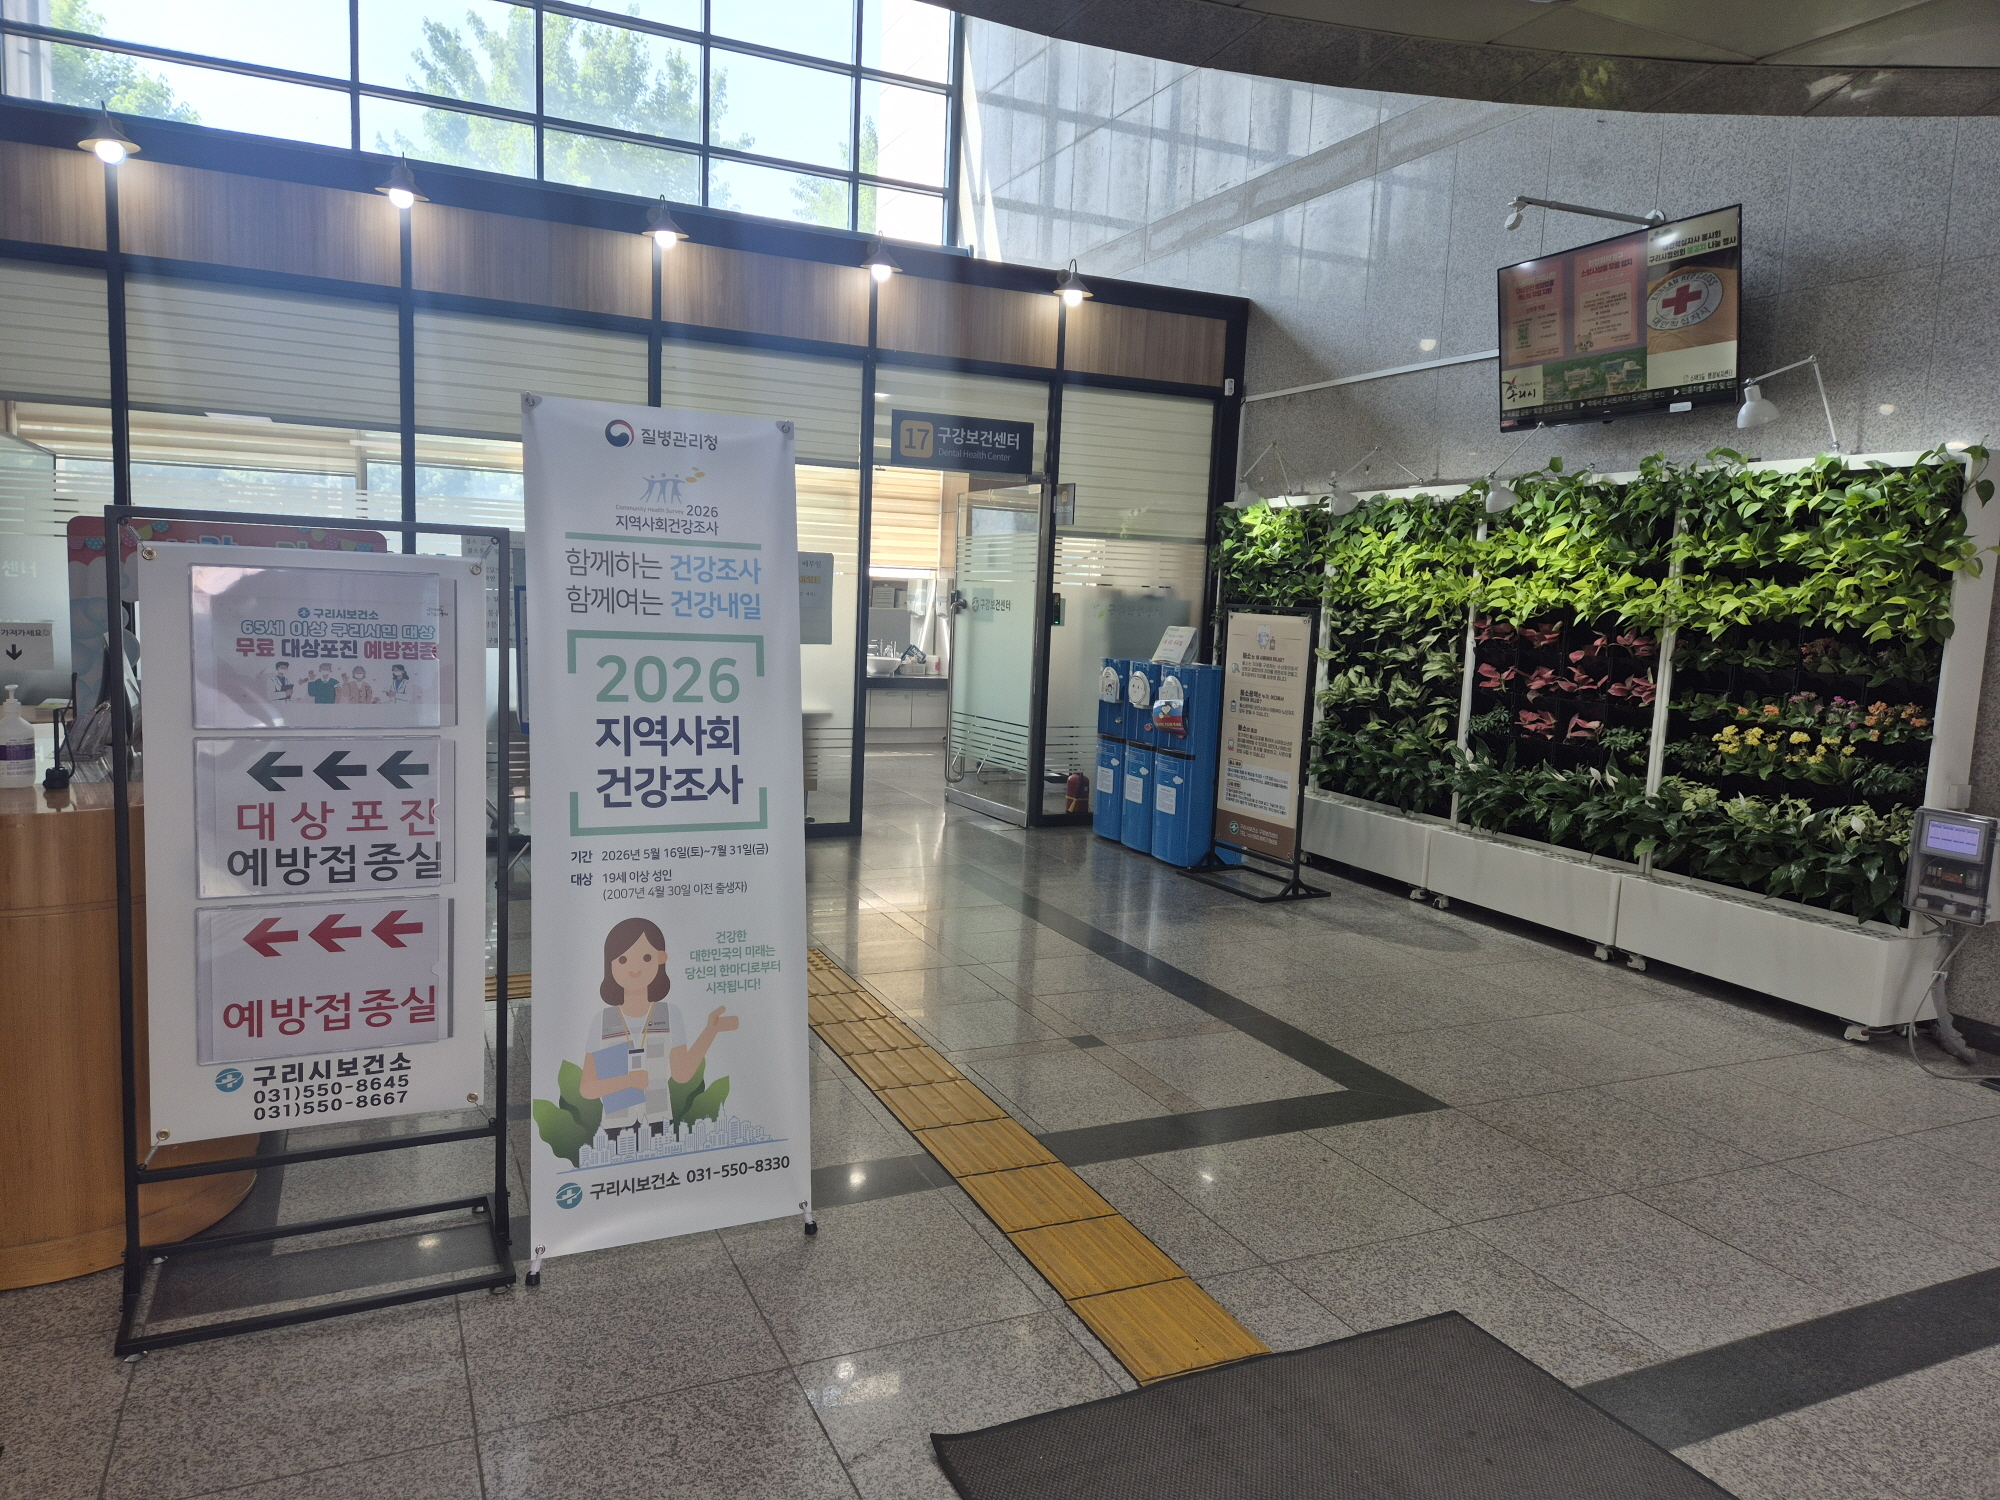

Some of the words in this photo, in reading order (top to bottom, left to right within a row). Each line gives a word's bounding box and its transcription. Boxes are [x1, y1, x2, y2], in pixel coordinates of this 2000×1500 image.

[641, 428, 718, 451] 질병관리청
[904, 427, 930, 450] 17
[937, 427, 1020, 450] 구강보건센터
[938, 447, 962, 459] Dental
[963, 448, 987, 460] Health
[988, 450, 1011, 462] Center
[615, 504, 647, 513] Community
[647, 506, 665, 514] Health
[686, 505, 719, 518] 2026
[615, 515, 719, 536] 지역사회건강조사
[565, 548, 663, 580] 함께하는
[670, 554, 762, 585] 건강조사
[313, 608, 379, 620] 구리시보건소
[566, 585, 664, 616] 함께여는
[670, 590, 761, 620] 건강내일
[980, 599, 1011, 612] 구강보건센터
[241, 620, 285, 637] 65세
[290, 621, 327, 638] 이상
[331, 623, 397, 639] 구리시민
[402, 625, 435, 640] 대상
[236, 637, 276, 657] 무료
[281, 638, 358, 659] 대상포진
[363, 640, 437, 660] 예방접종
[596, 655, 740, 703] 2026
[595, 715, 740, 757] 지역사회
[596, 765, 744, 808] 건강조사
[227, 841, 441, 887] 예방접종실
[571, 850, 593, 864] 기간
[601, 849, 640, 862] 2026년
[643, 847, 661, 860] 5월
[730, 843, 769, 857] 31일(금)
[571, 873, 593, 886] 대상
[602, 871, 627, 884] 19세
[629, 870, 649, 883] 이상
[652, 869, 672, 882] 성인
[603, 886, 645, 901] (2007년
[648, 885, 665, 898] 4월
[668, 884, 691, 897] 30일
[693, 882, 714, 895] 이전
[715, 881, 748, 894] 출생자)
[716, 930, 747, 943] 건강한
[690, 946, 742, 962] 대한민국의
[745, 944, 776, 958] 미래는
[685, 964, 717, 981] 당신의
[719, 959, 781, 977] 한마디로부터
[706, 978, 761, 995] 시작됩니다!
[223, 985, 436, 1038] 예방접종실
[253, 1053, 412, 1087] 구리시보건소
[253, 1075, 409, 1104] 031)550-8645
[253, 1090, 408, 1120] 031)550-8667
[590, 1171, 681, 1200] 구리시보건소
[686, 1156, 790, 1183] 031-550-8330
